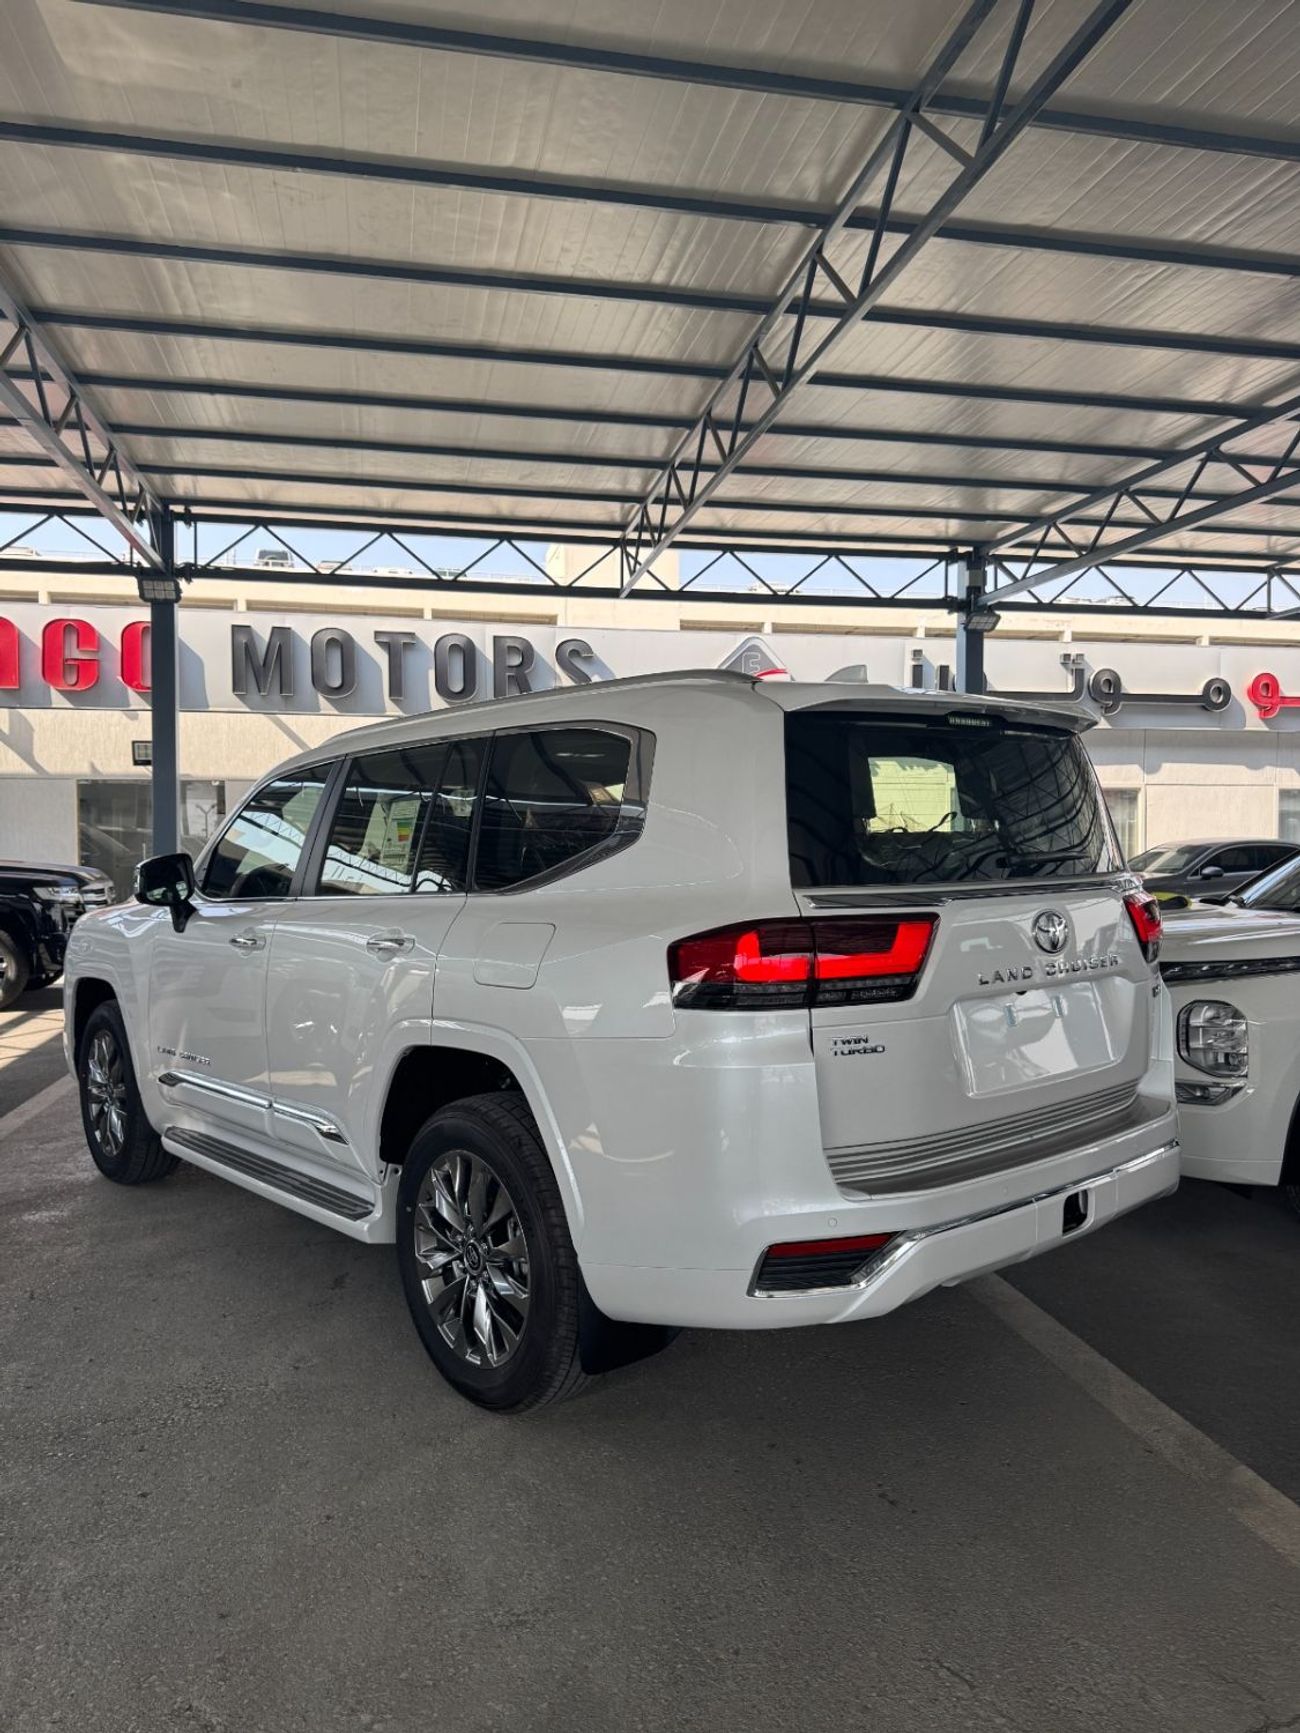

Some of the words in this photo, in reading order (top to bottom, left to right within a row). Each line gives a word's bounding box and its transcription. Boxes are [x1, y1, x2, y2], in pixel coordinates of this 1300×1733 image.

[231, 623, 594, 702] MOTORS
[978, 966, 1033, 986] LAND
[1044, 953, 1120, 977] CRUISER
[832, 1035, 869, 1046] TWIN
